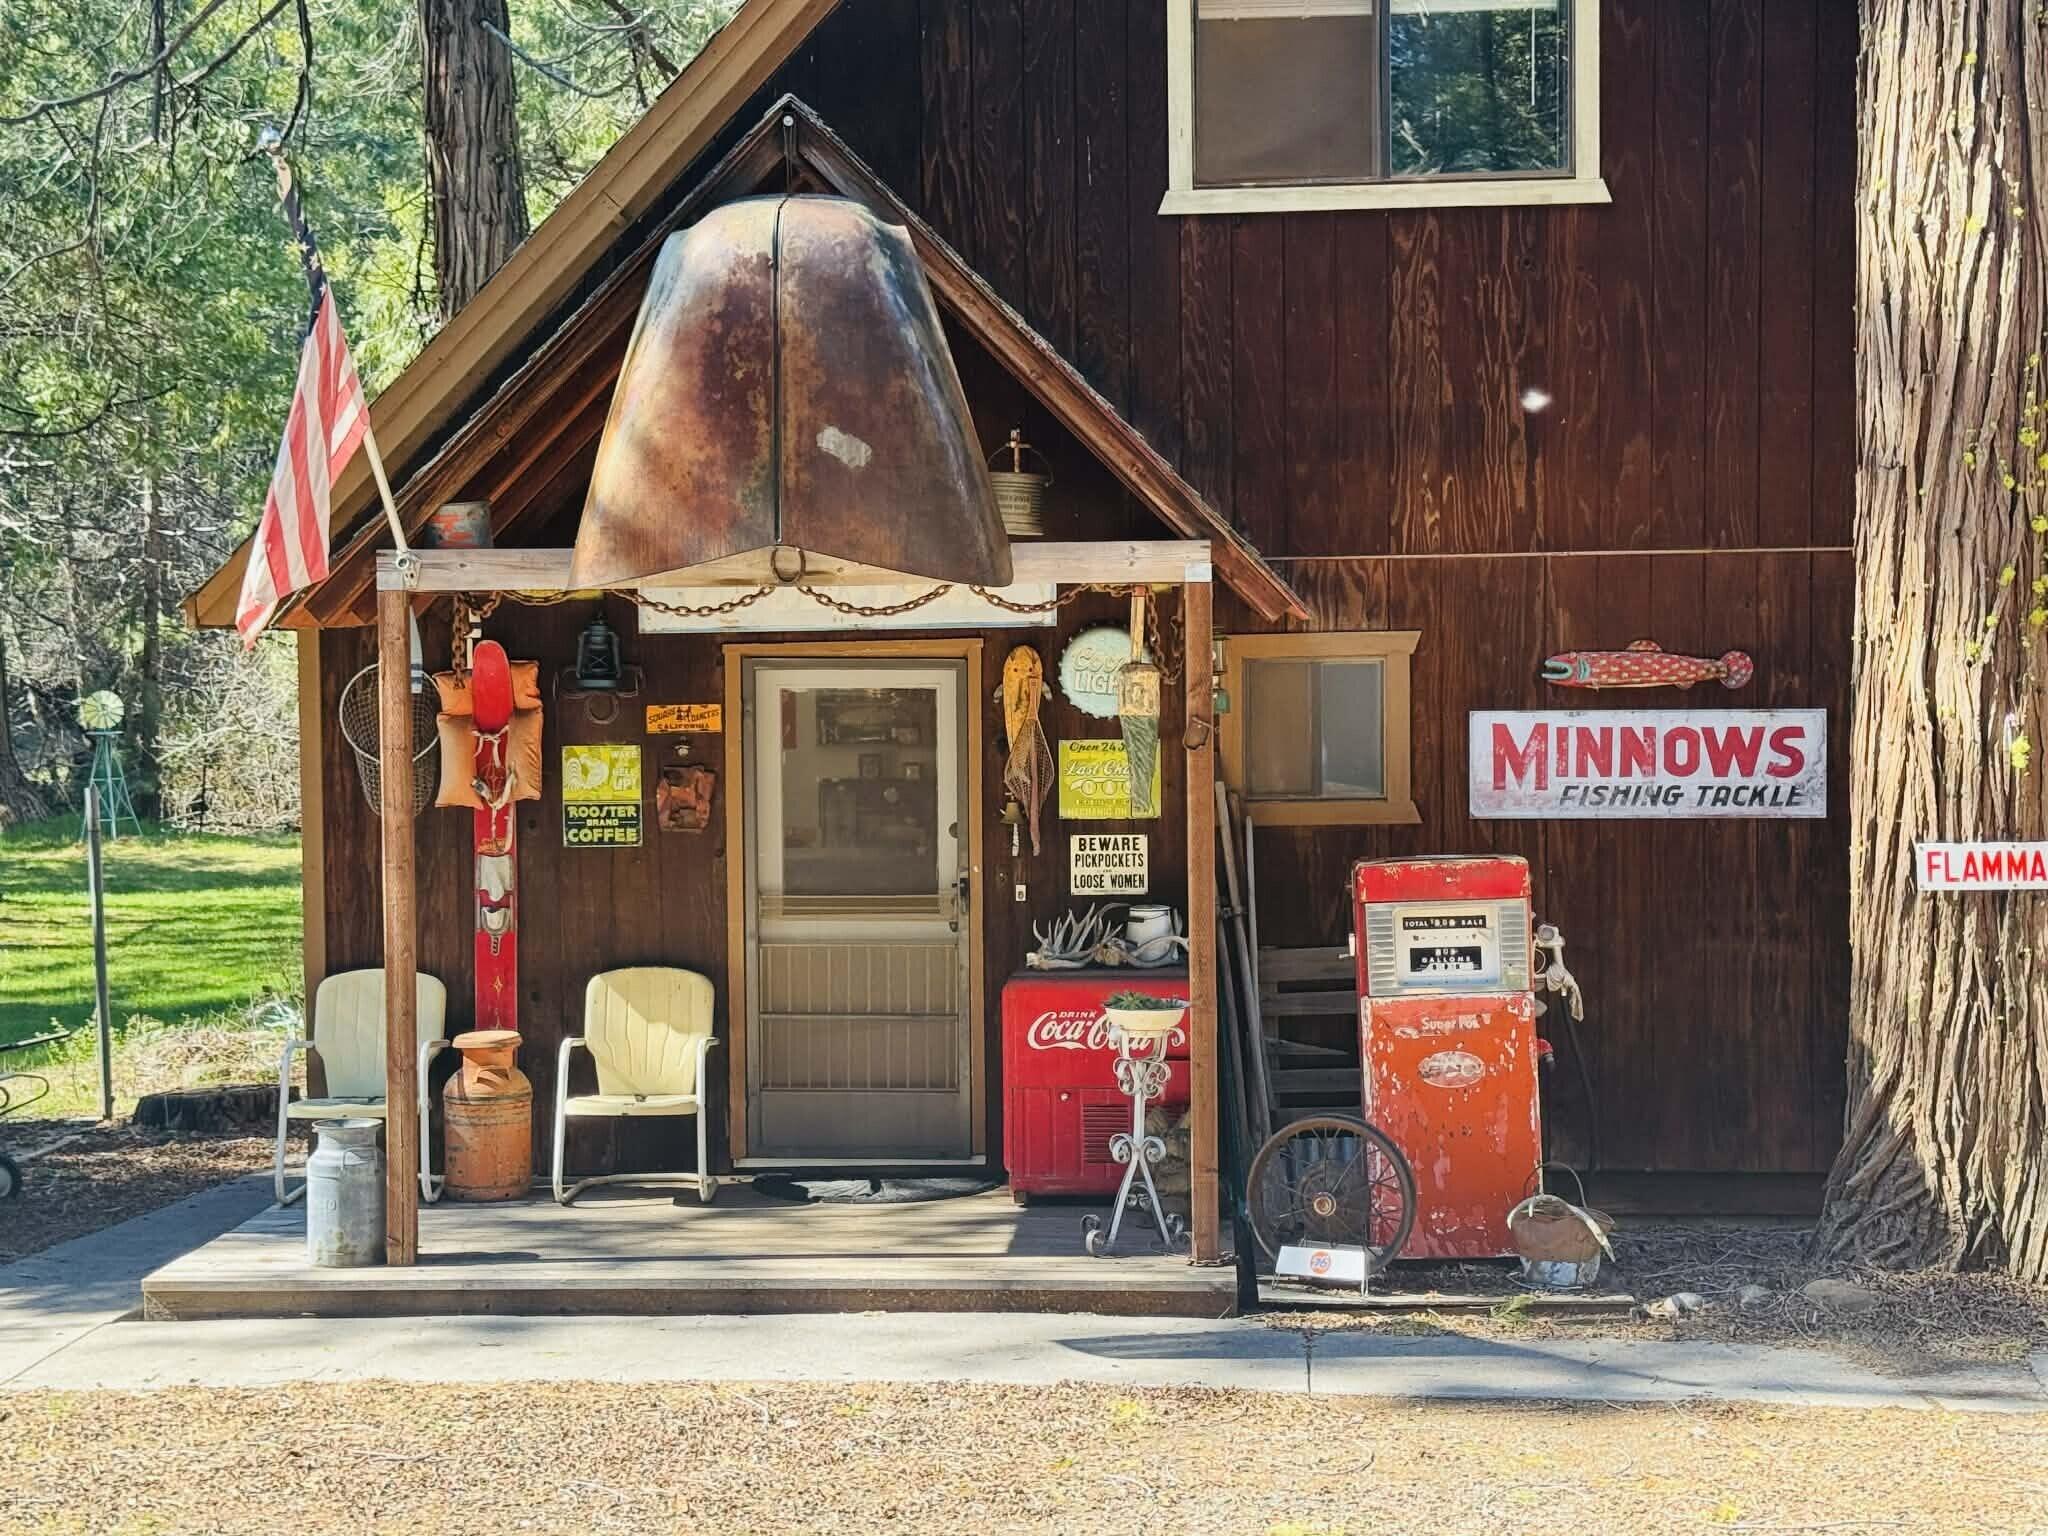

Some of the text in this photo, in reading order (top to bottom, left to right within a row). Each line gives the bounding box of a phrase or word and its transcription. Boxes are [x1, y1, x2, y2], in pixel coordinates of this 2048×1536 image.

[1069, 742, 1099, 753] Open
[1101, 742, 1116, 752] 24
[1492, 723, 1806, 791] MINNOWS
[1065, 759, 1130, 776] Last Cha
[1560, 784, 1803, 807] FISHING TACKLE
[567, 805, 637, 818] ROOSTER
[585, 819, 619, 827] BRAND
[567, 828, 637, 843] COFFEE
[1078, 837, 1141, 852] BEWARE
[1074, 853, 1145, 868] PICKPOCKETS
[1926, 850, 2048, 882] FLAMMA
[1074, 873, 1145, 889] LOOSE WOMEN
[1405, 920, 1429, 928] TOTAL
[1461, 918, 1484, 927] SALE
[1421, 956, 1472, 964] GALLONS
[1058, 1010, 1098, 1019] DRINK
